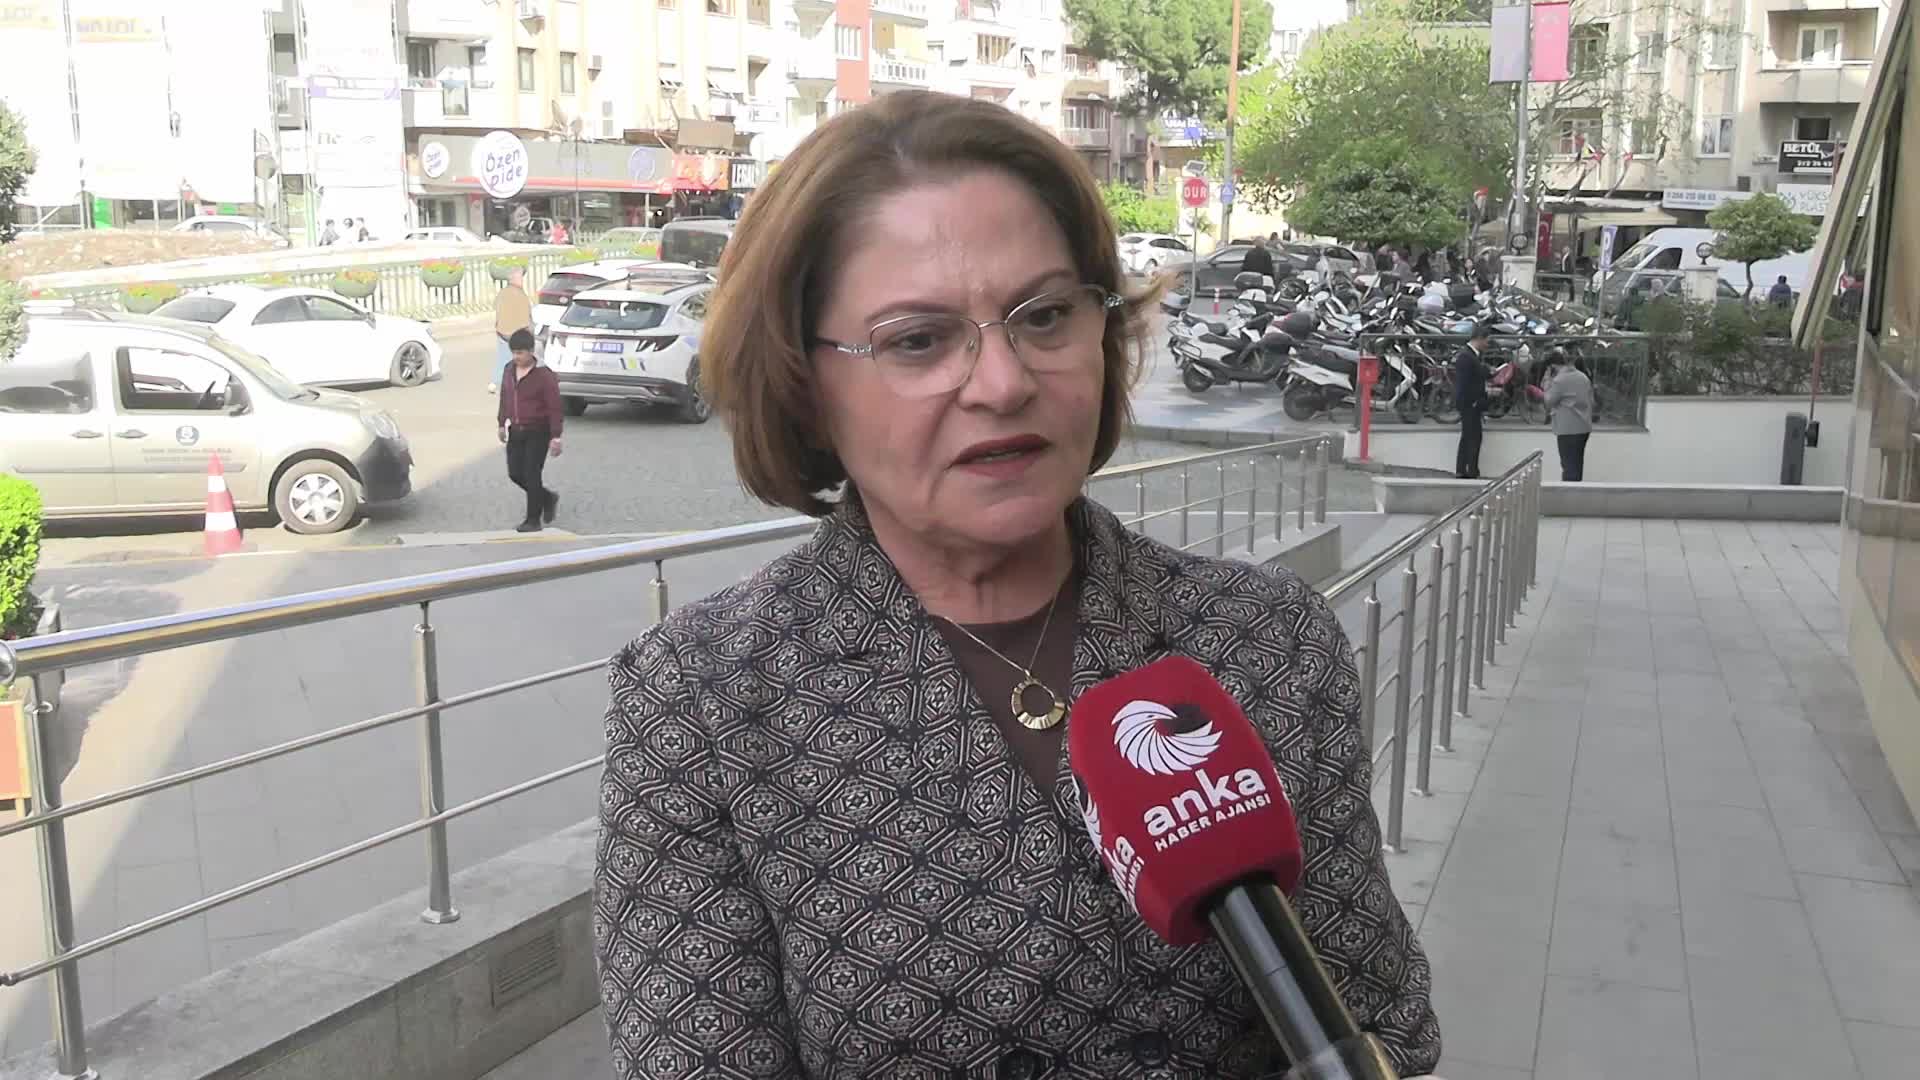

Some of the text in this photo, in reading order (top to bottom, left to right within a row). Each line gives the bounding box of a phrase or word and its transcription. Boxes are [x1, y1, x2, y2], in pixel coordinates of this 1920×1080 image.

[486, 148, 520, 173] Özen
[490, 165, 523, 191] pide
[1184, 186, 1207, 198] DUR
[1143, 767, 1266, 837] anka
[1154, 793, 1272, 853] HABER AJANSI
